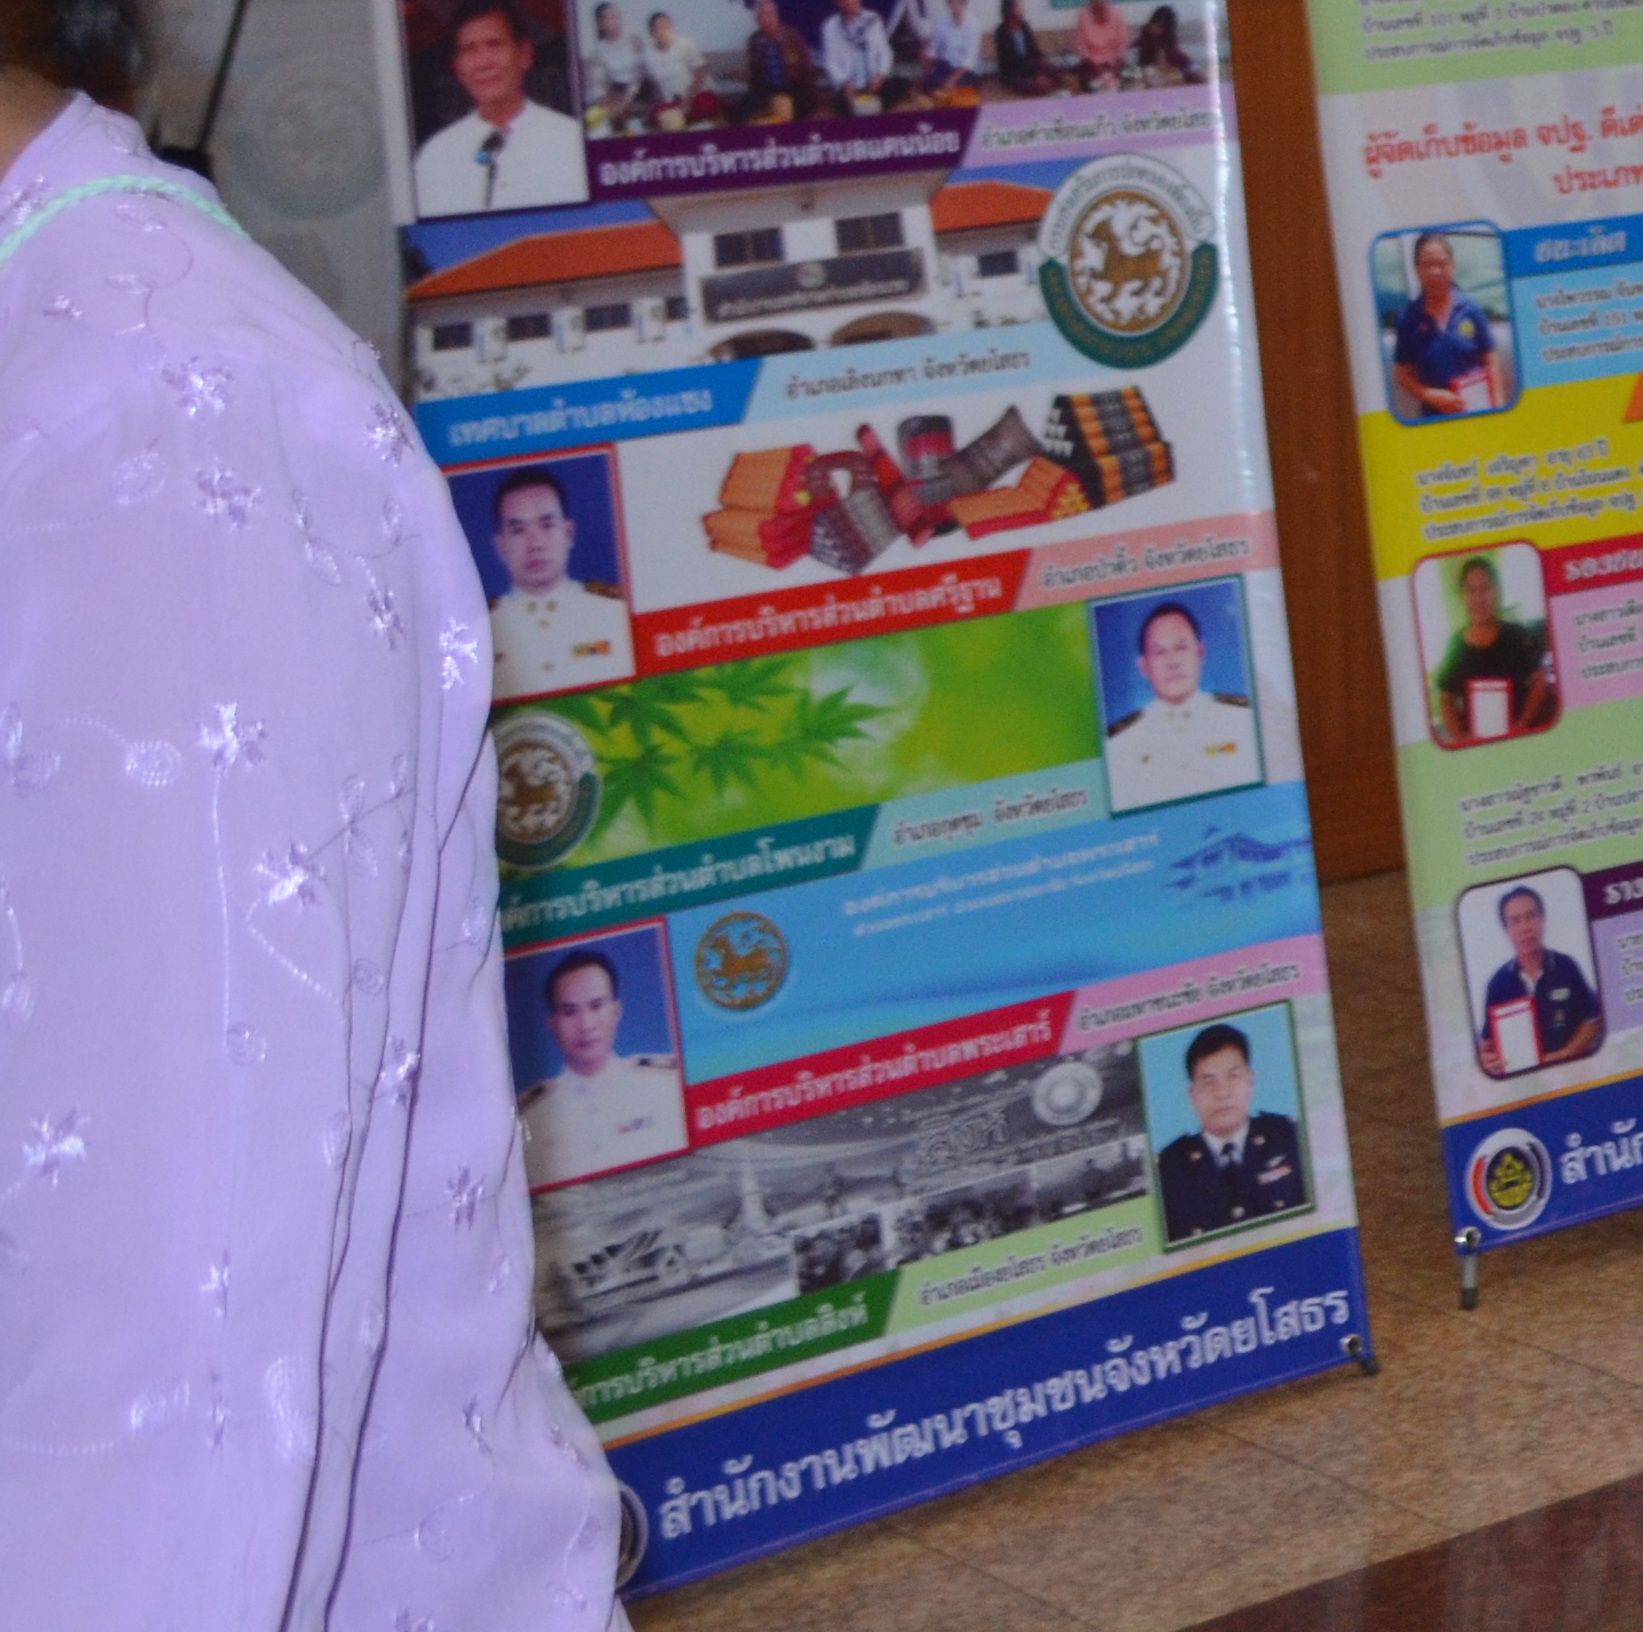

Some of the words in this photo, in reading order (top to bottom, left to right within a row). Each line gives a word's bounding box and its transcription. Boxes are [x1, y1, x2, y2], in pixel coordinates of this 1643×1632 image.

[1364, 121, 1528, 180] ผู้จัดเก็บข้อมูล
[1535, 114, 1593, 153] จปฐ.
[658, 1288, 1350, 1540] สำนักงานพัฒนาชุมชนจังหวัดยโสธร
